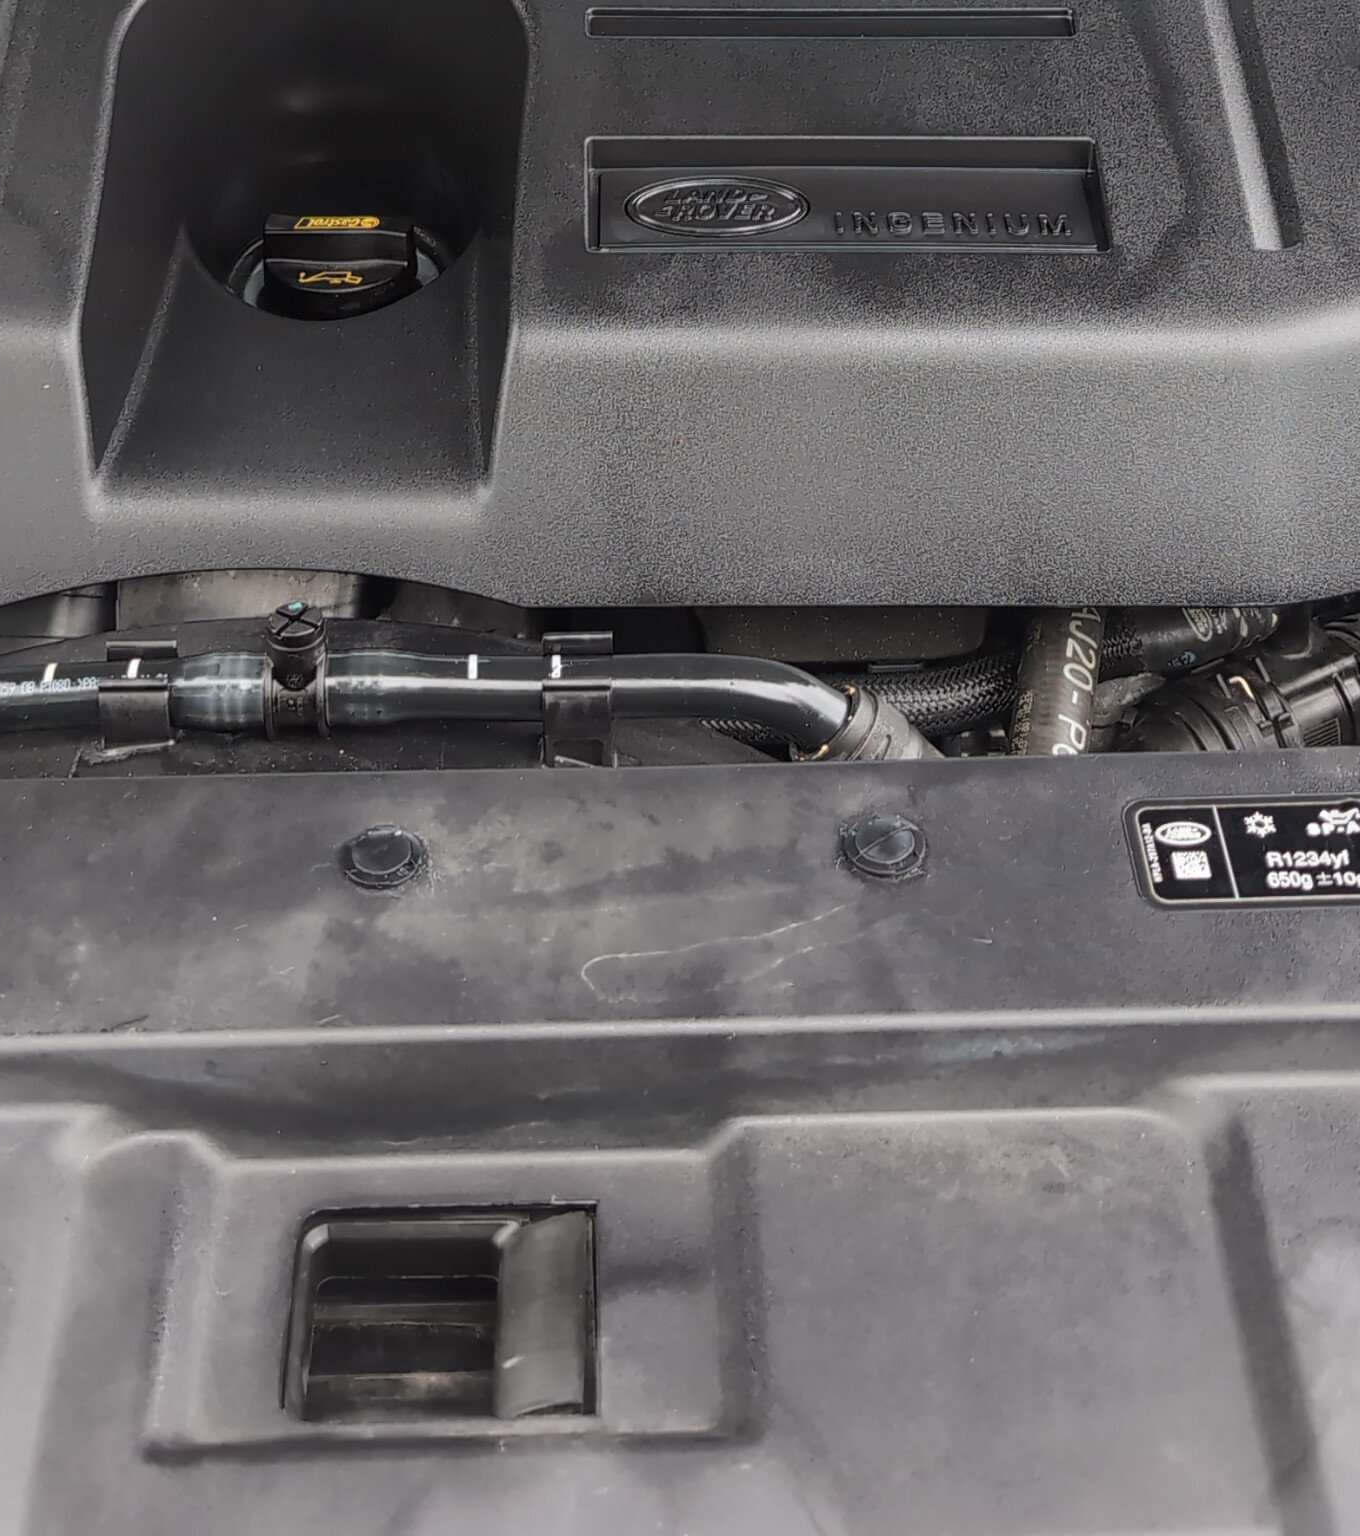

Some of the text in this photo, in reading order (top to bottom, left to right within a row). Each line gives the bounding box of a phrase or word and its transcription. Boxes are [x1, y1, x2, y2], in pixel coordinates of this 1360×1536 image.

[307, 217, 363, 229] Castrol
[671, 204, 777, 222] ROVER
[833, 210, 1074, 239] INGENIUM
[1266, 869, 1315, 892] 650g
